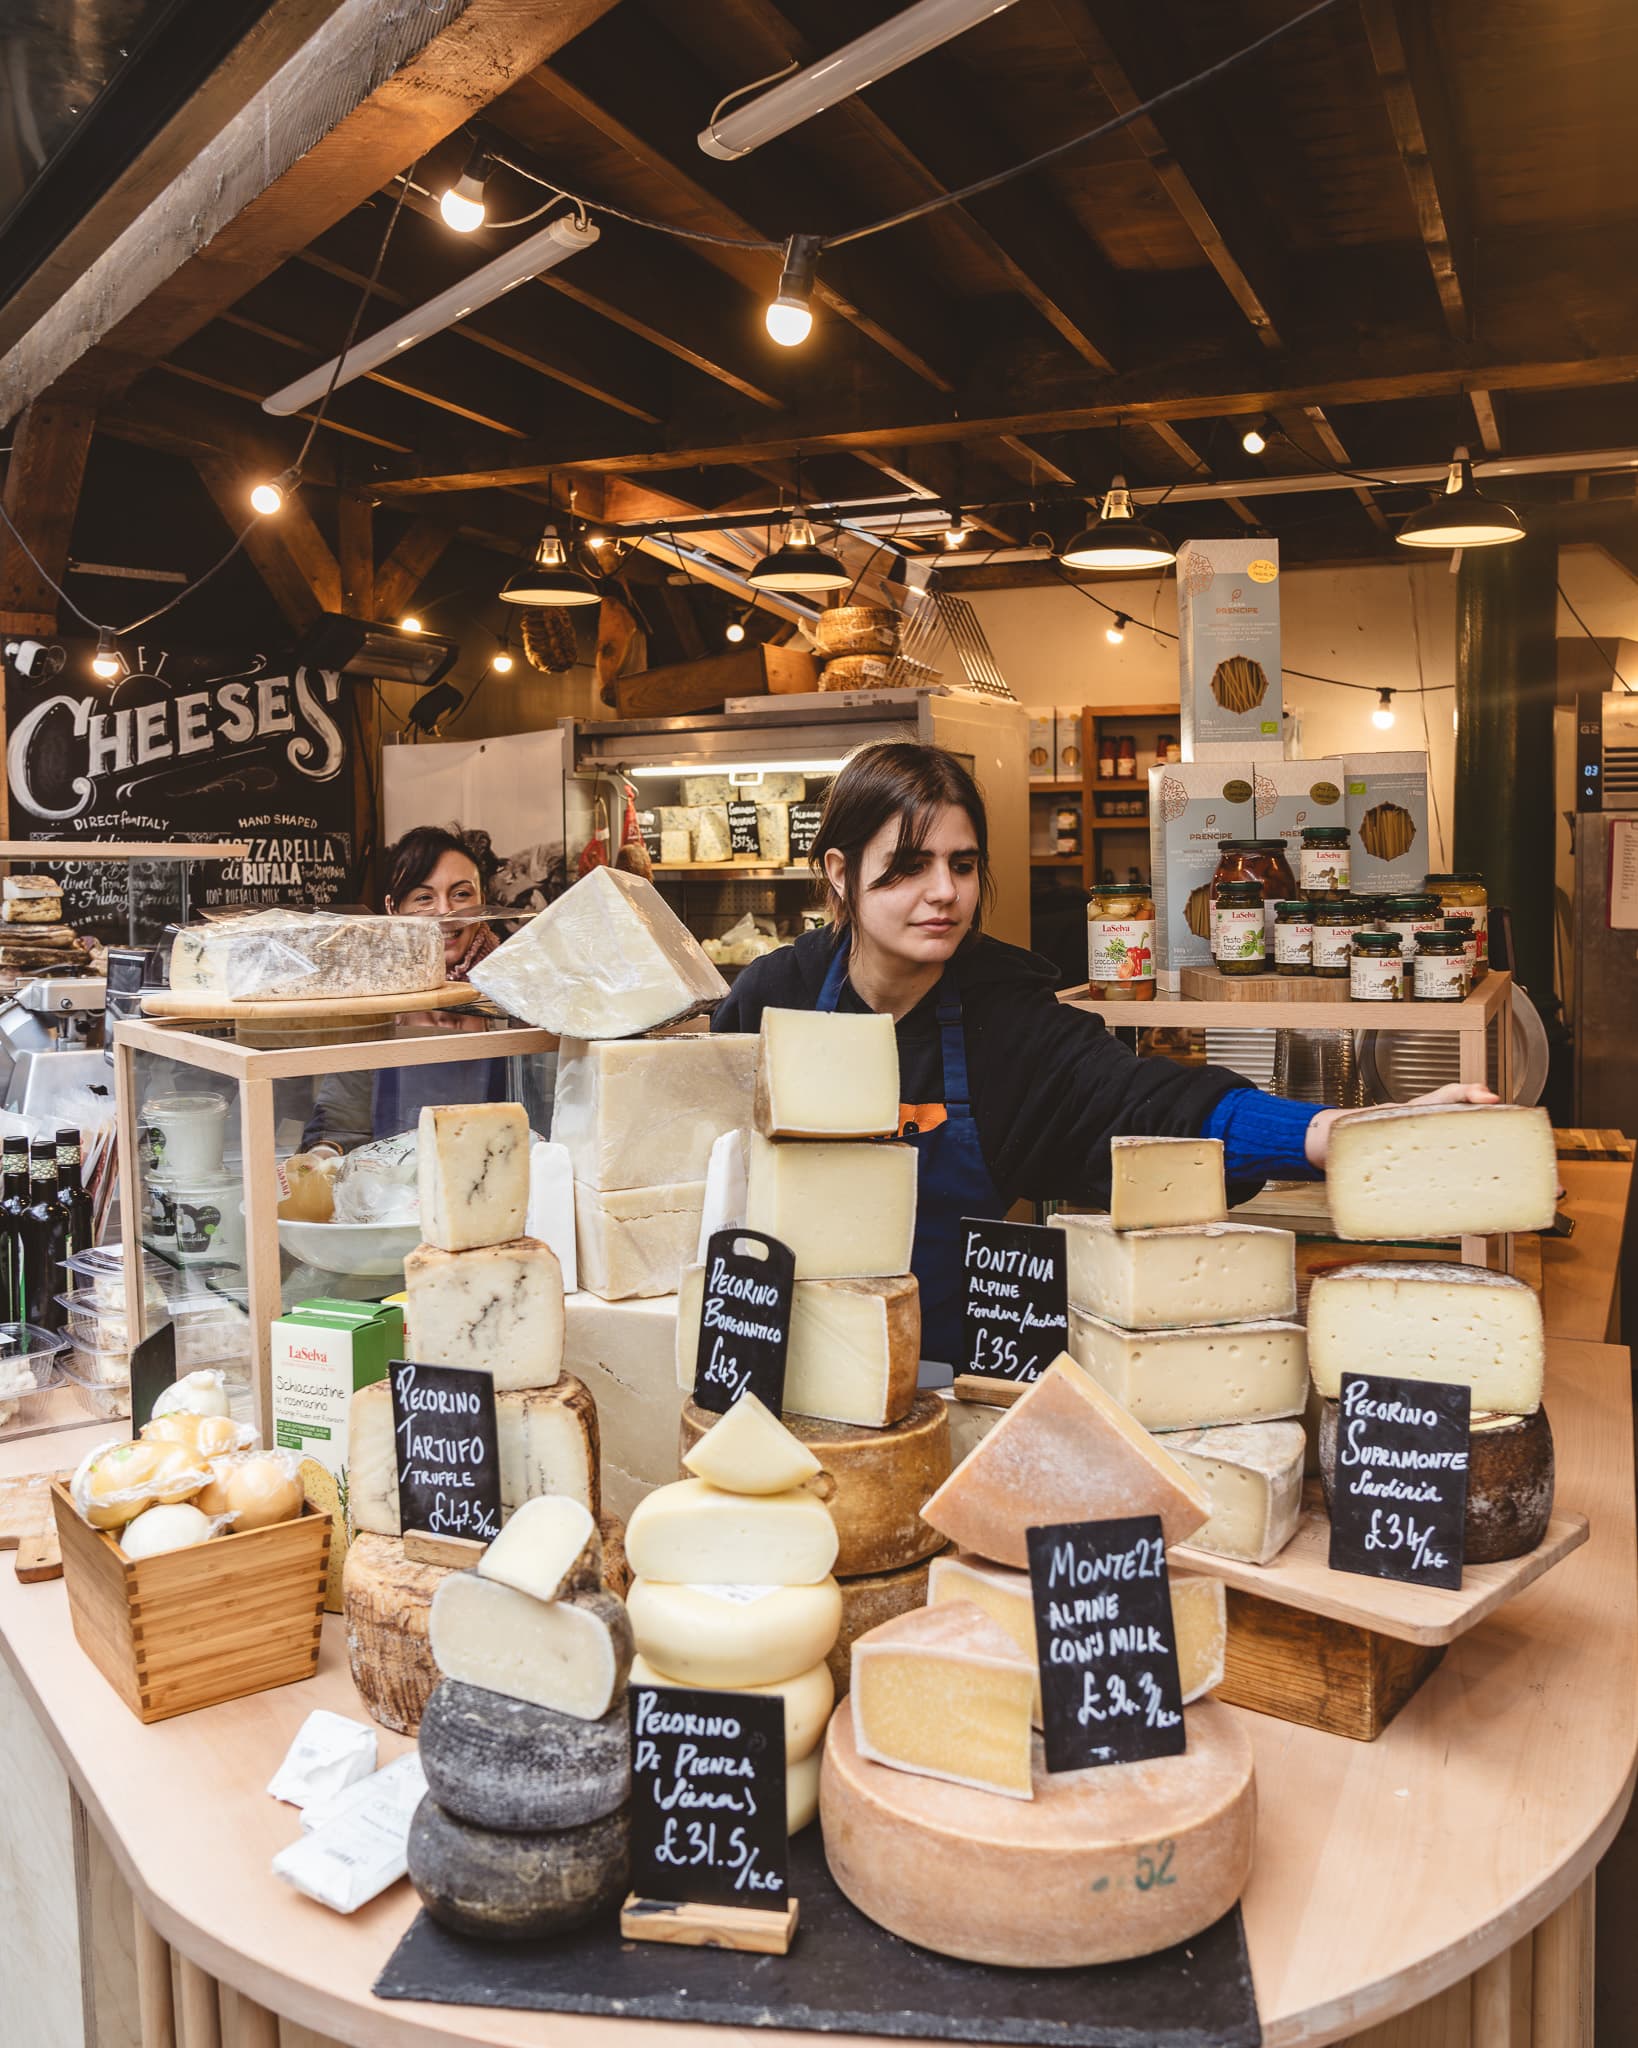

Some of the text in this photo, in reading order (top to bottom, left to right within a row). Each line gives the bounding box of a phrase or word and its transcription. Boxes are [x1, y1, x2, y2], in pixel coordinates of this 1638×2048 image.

[8, 666, 346, 819] CHEESES
[73, 814, 120, 831] DIRECT
[137, 815, 170, 831] ITALY
[238, 814, 318, 829] HAND SHAPED
[1189, 832, 1233, 840] PRENCIPE
[1279, 830, 1302, 838] PREN
[221, 862, 241, 881] di
[242, 862, 302, 886] BUFALA
[78, 889, 129, 912] Friday
[1231, 911, 1256, 919] LaSelva
[1102, 924, 1131, 932] LaSelva
[1223, 935, 1242, 945] Pesto
[964, 1231, 1054, 1283] FONTINA
[708, 1256, 779, 1307] PECORINO
[969, 1276, 1021, 1299] ALPINE
[288, 1345, 328, 1364] LaSelva
[395, 1364, 481, 1415] PECORINO
[1343, 1380, 1438, 1427] PECORINO
[397, 1412, 485, 1465] TARTUFO
[1341, 1419, 1470, 1470] SUPRAMONTE
[1349, 1469, 1443, 1502] Sardinia
[1049, 1593, 1120, 1631] ALPINE
[1109, 1625, 1169, 1657] MILK
[635, 1691, 741, 1739] PECORINO
[675, 1743, 756, 1779] PIENZA
[1135, 1838, 1177, 1891] 52
